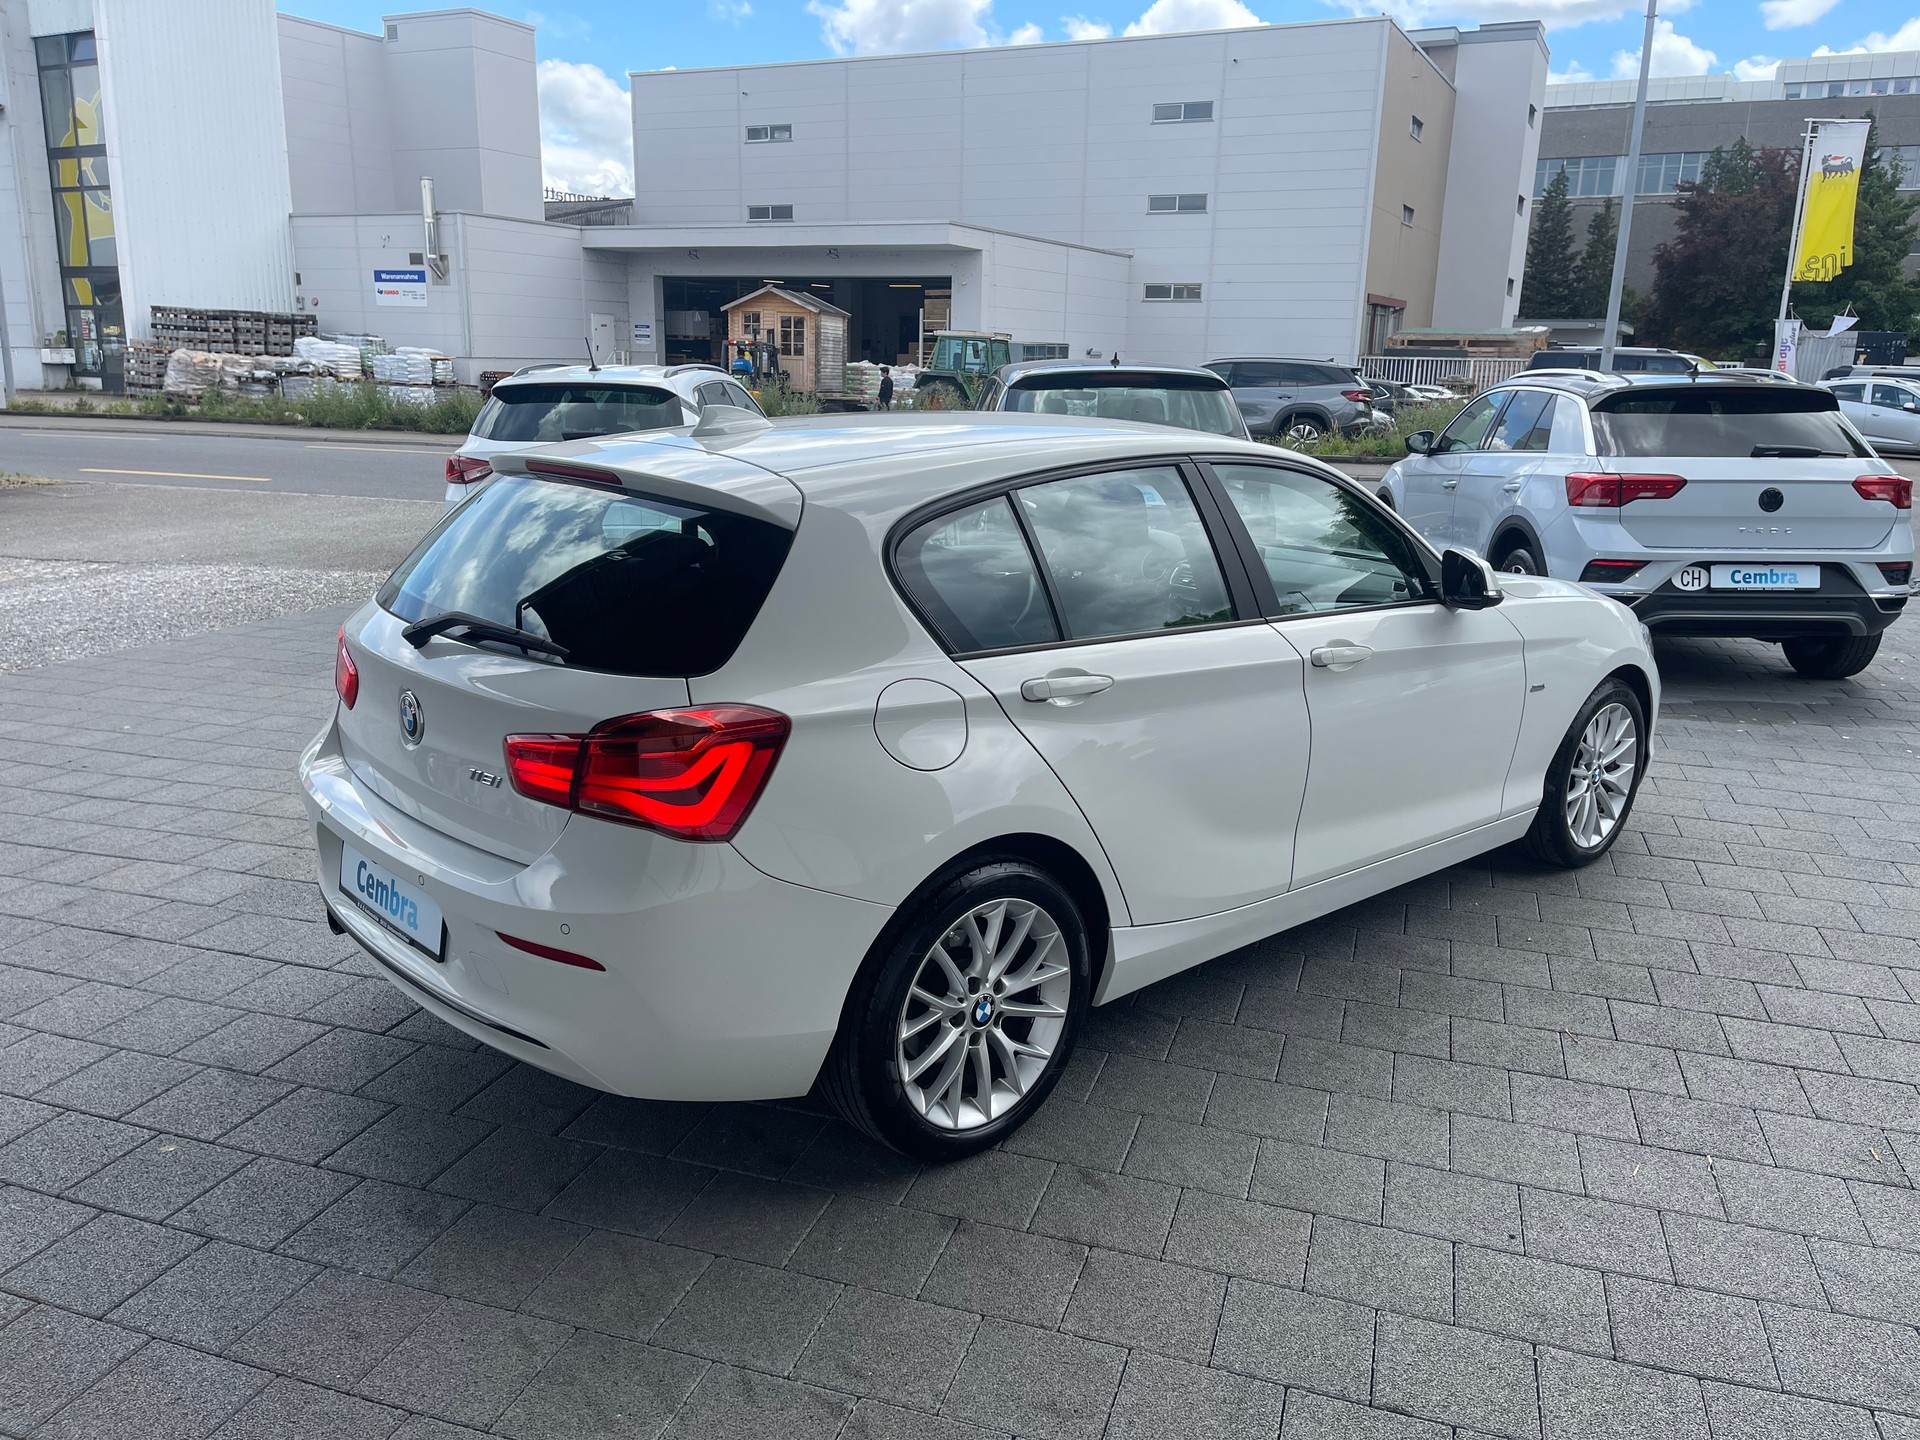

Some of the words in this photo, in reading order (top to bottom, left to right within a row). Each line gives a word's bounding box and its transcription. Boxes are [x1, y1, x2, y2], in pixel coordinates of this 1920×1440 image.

[1789, 327, 1797, 346] plus
[1680, 570, 1701, 588] CH
[1730, 569, 1799, 585] Cembra
[357, 860, 418, 931] Cembra
